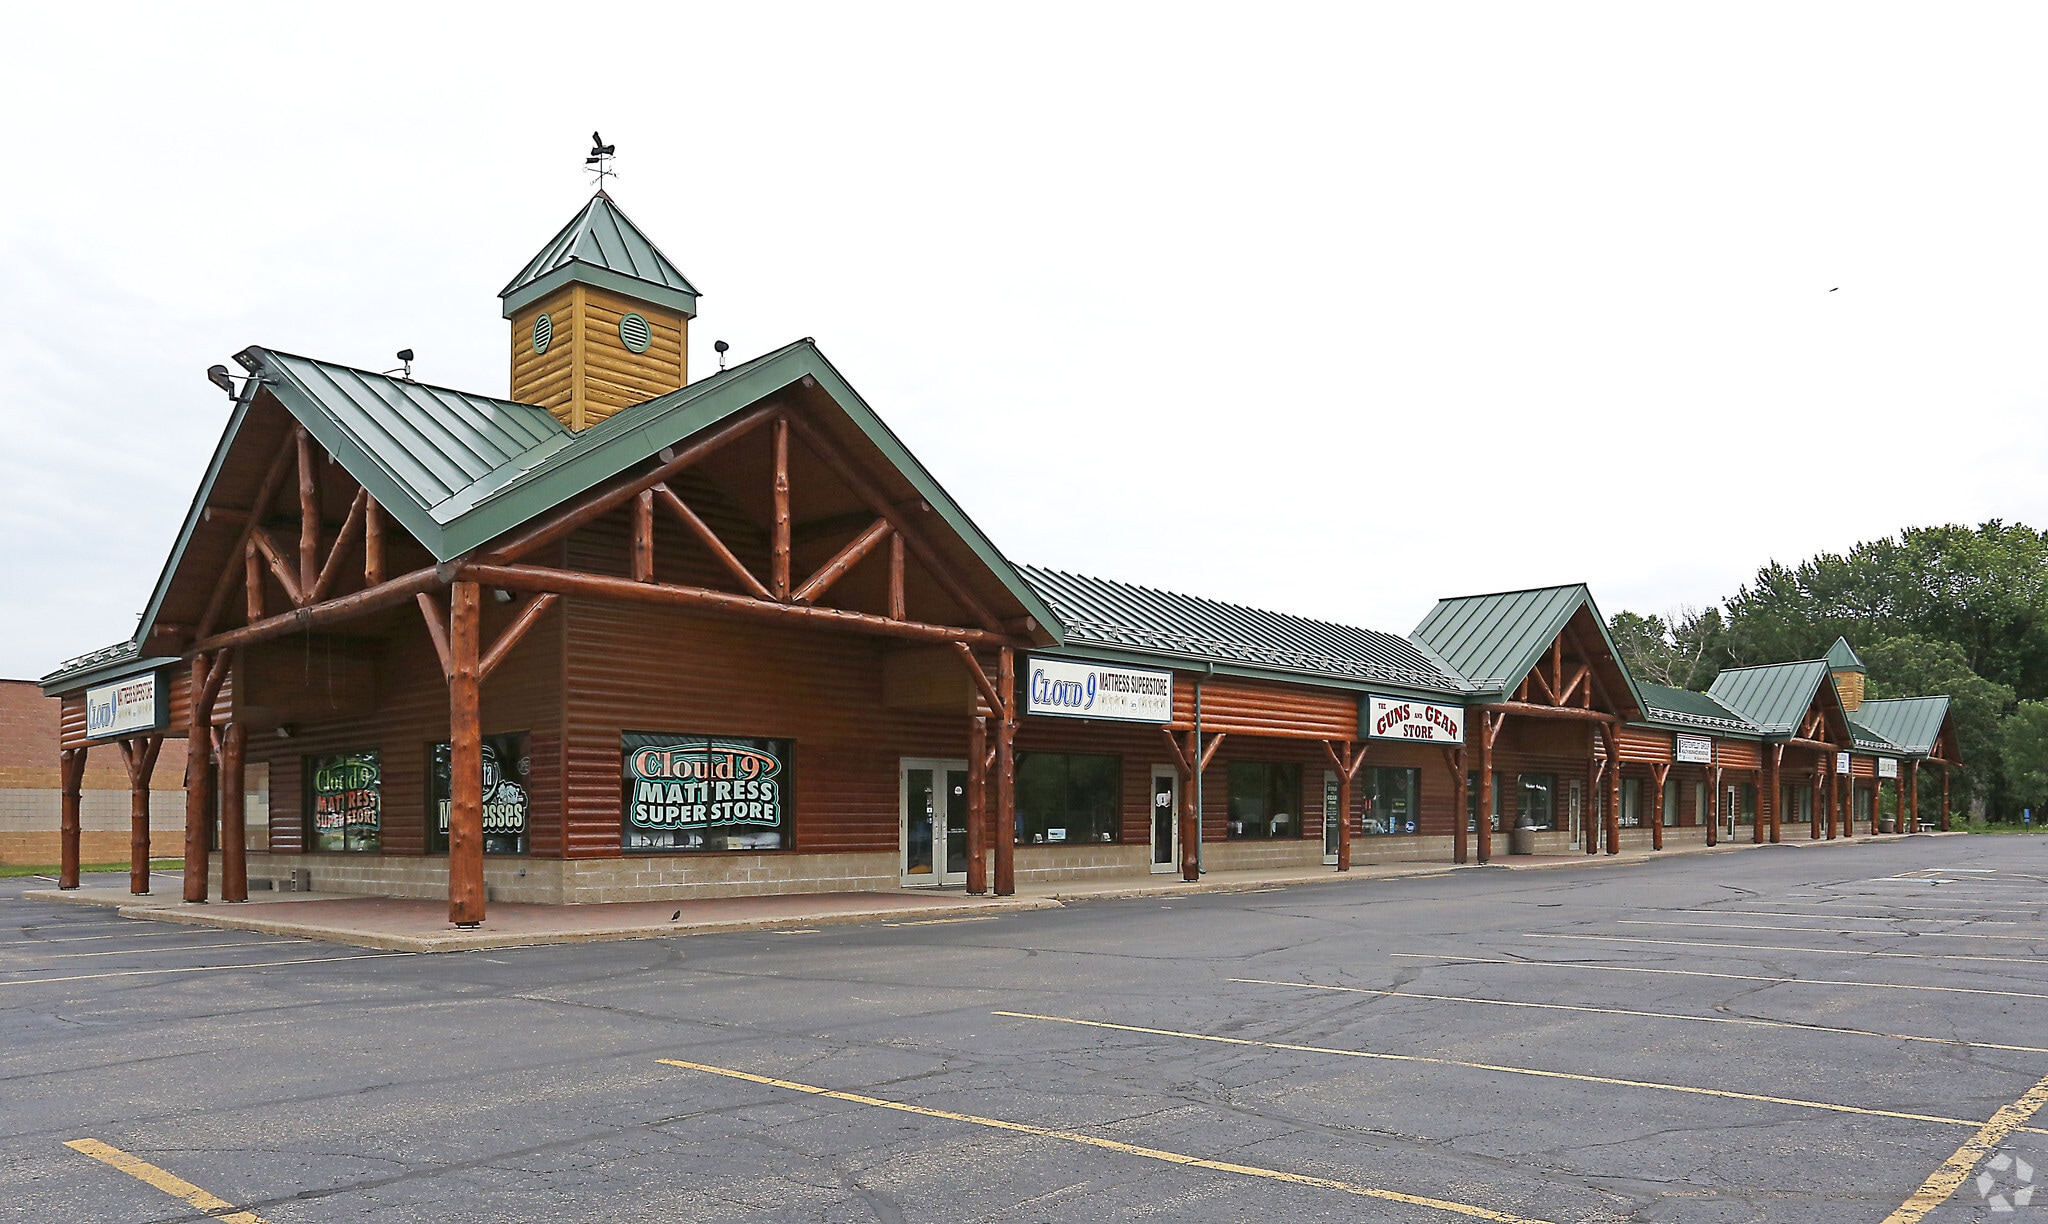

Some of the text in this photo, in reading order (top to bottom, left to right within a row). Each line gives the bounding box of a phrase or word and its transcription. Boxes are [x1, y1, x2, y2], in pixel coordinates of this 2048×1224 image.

[1032, 668, 1097, 711] CLOUD 9
[1099, 672, 1168, 697] MATTRESS SUPERSTORE
[1377, 704, 1410, 735] GUNS
[1425, 705, 1457, 740] GEAR
[1403, 724, 1433, 739] STORE
[636, 750, 760, 780] Cloud 9
[317, 789, 376, 812] MATTRESS
[638, 780, 773, 804] MATTRESS
[346, 806, 377, 825] STORE
[636, 801, 774, 823] SUPER STORE
